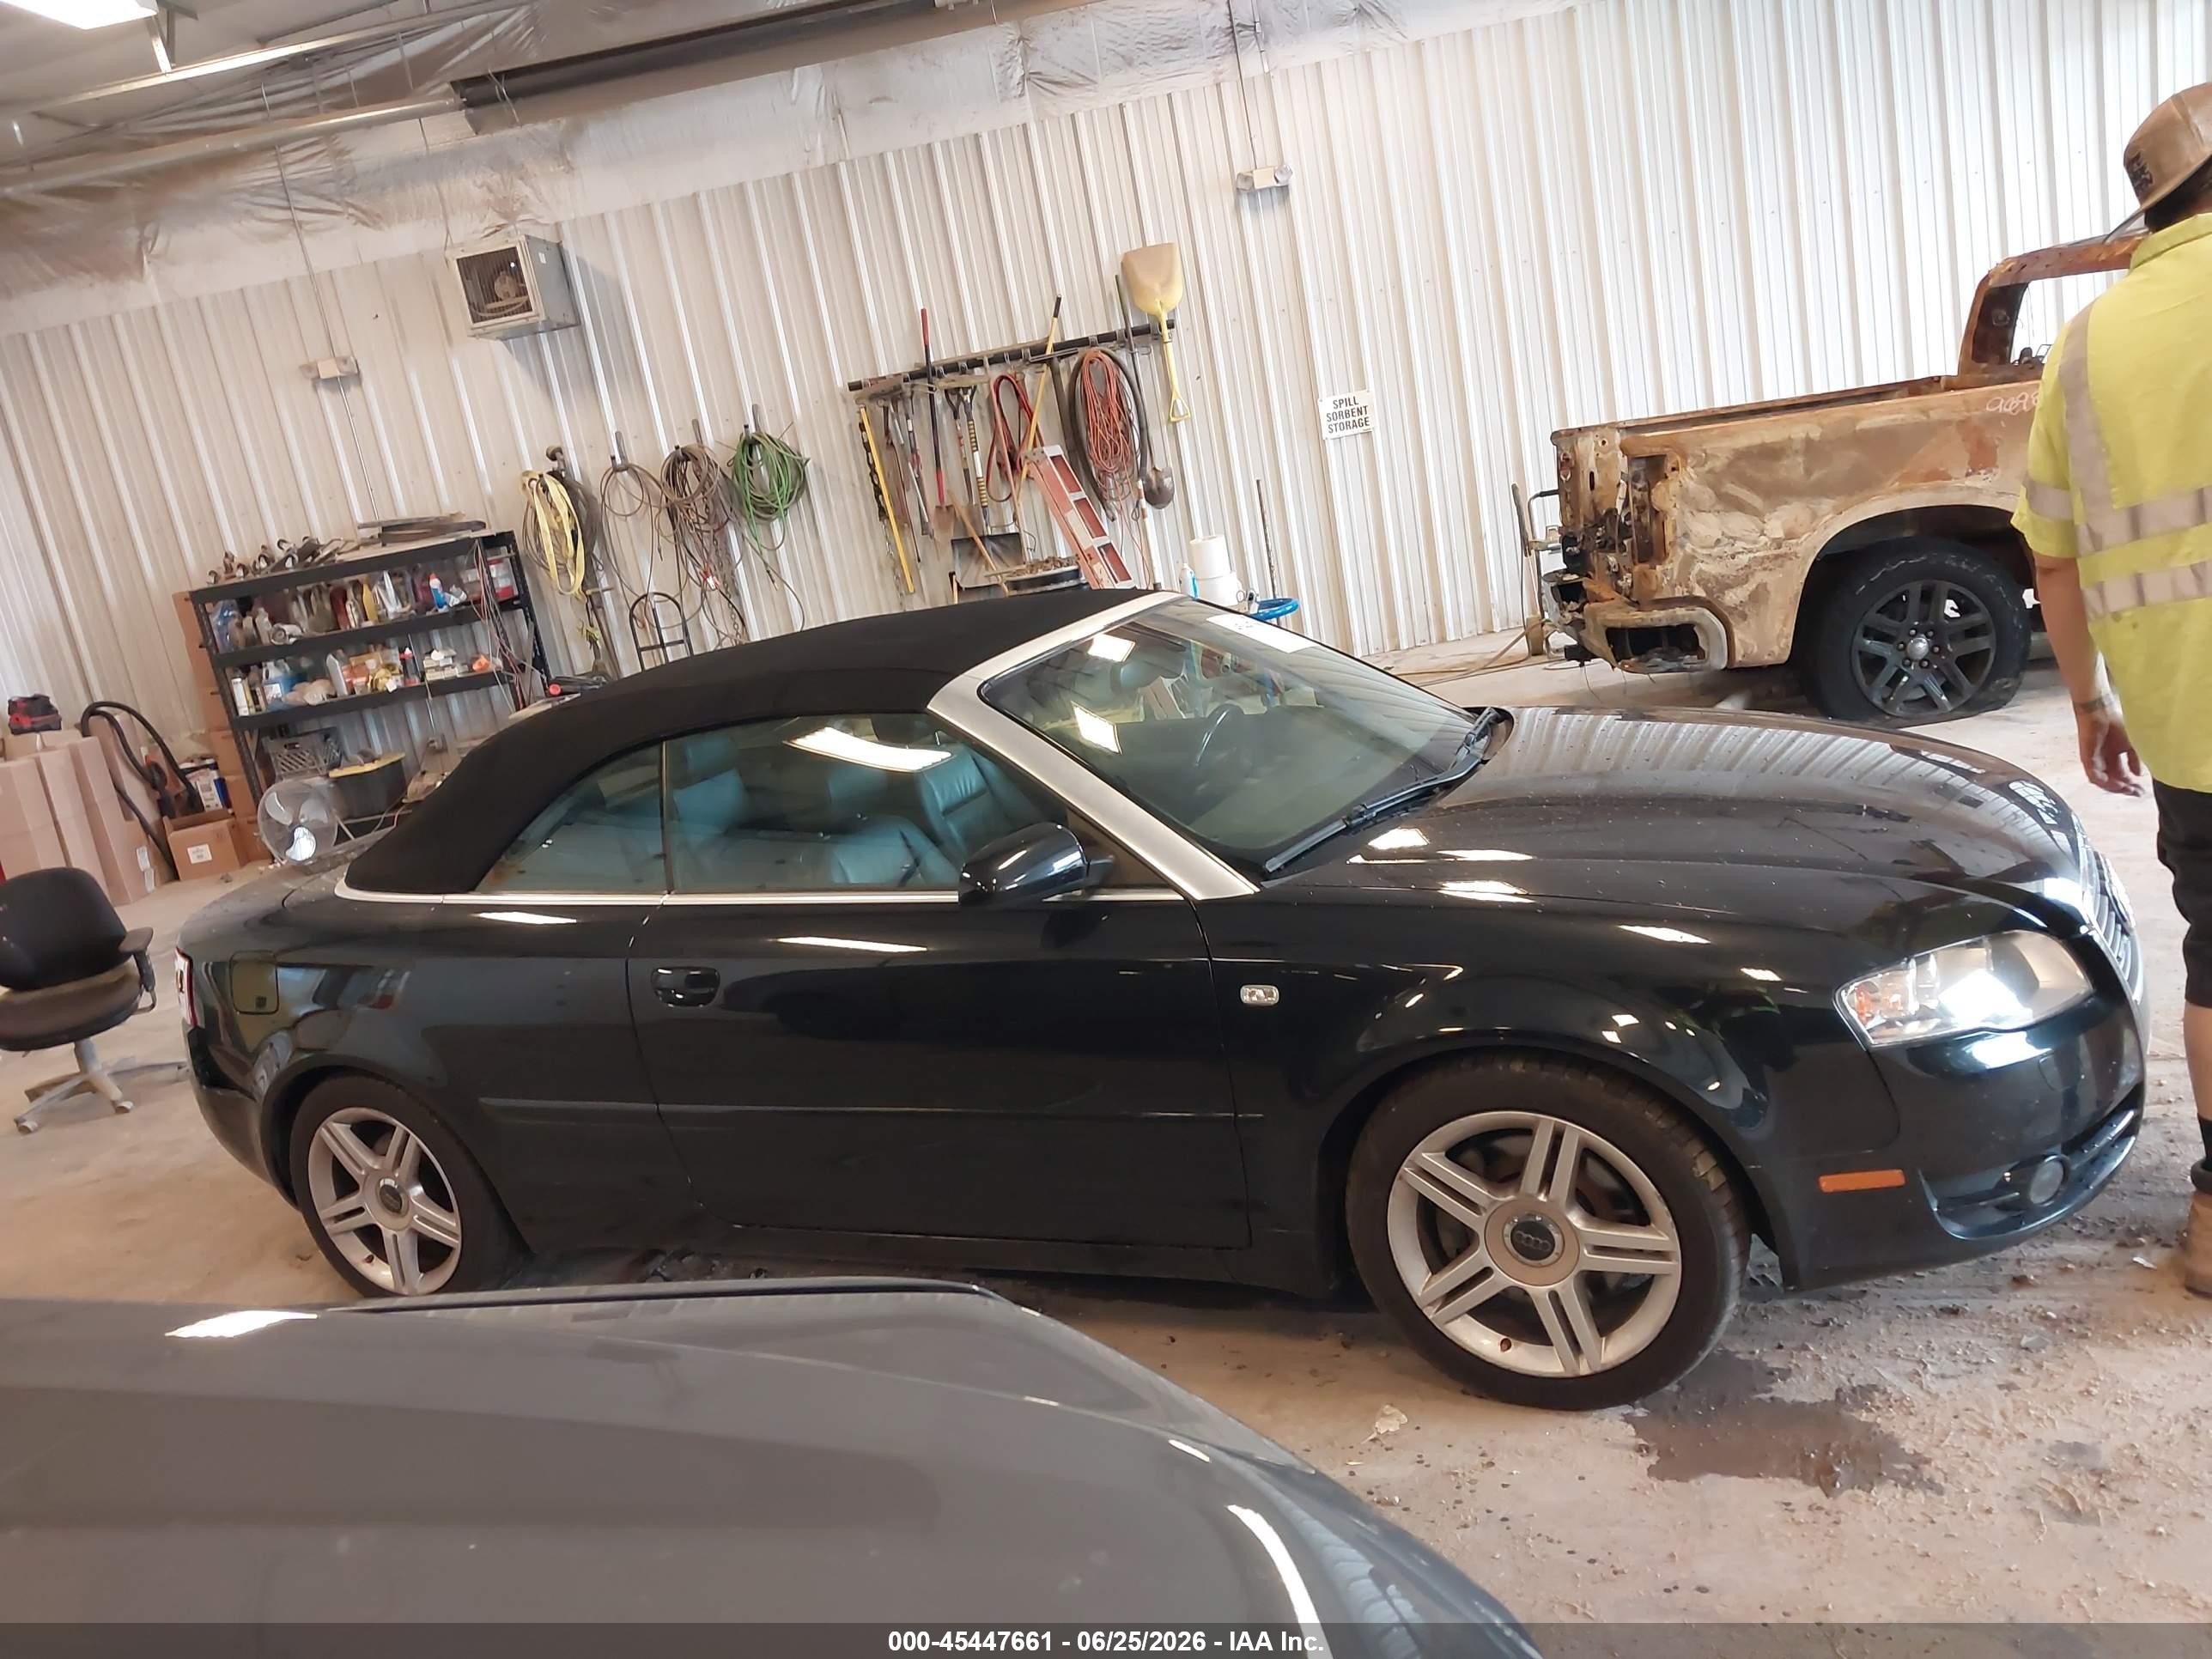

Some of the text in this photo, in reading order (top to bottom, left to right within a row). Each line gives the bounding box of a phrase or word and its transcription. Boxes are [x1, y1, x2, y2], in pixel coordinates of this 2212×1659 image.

[1333, 396, 1359, 410] SPILL
[1326, 405, 1369, 422] SORBENT
[1328, 416, 1370, 434] STORAGE
